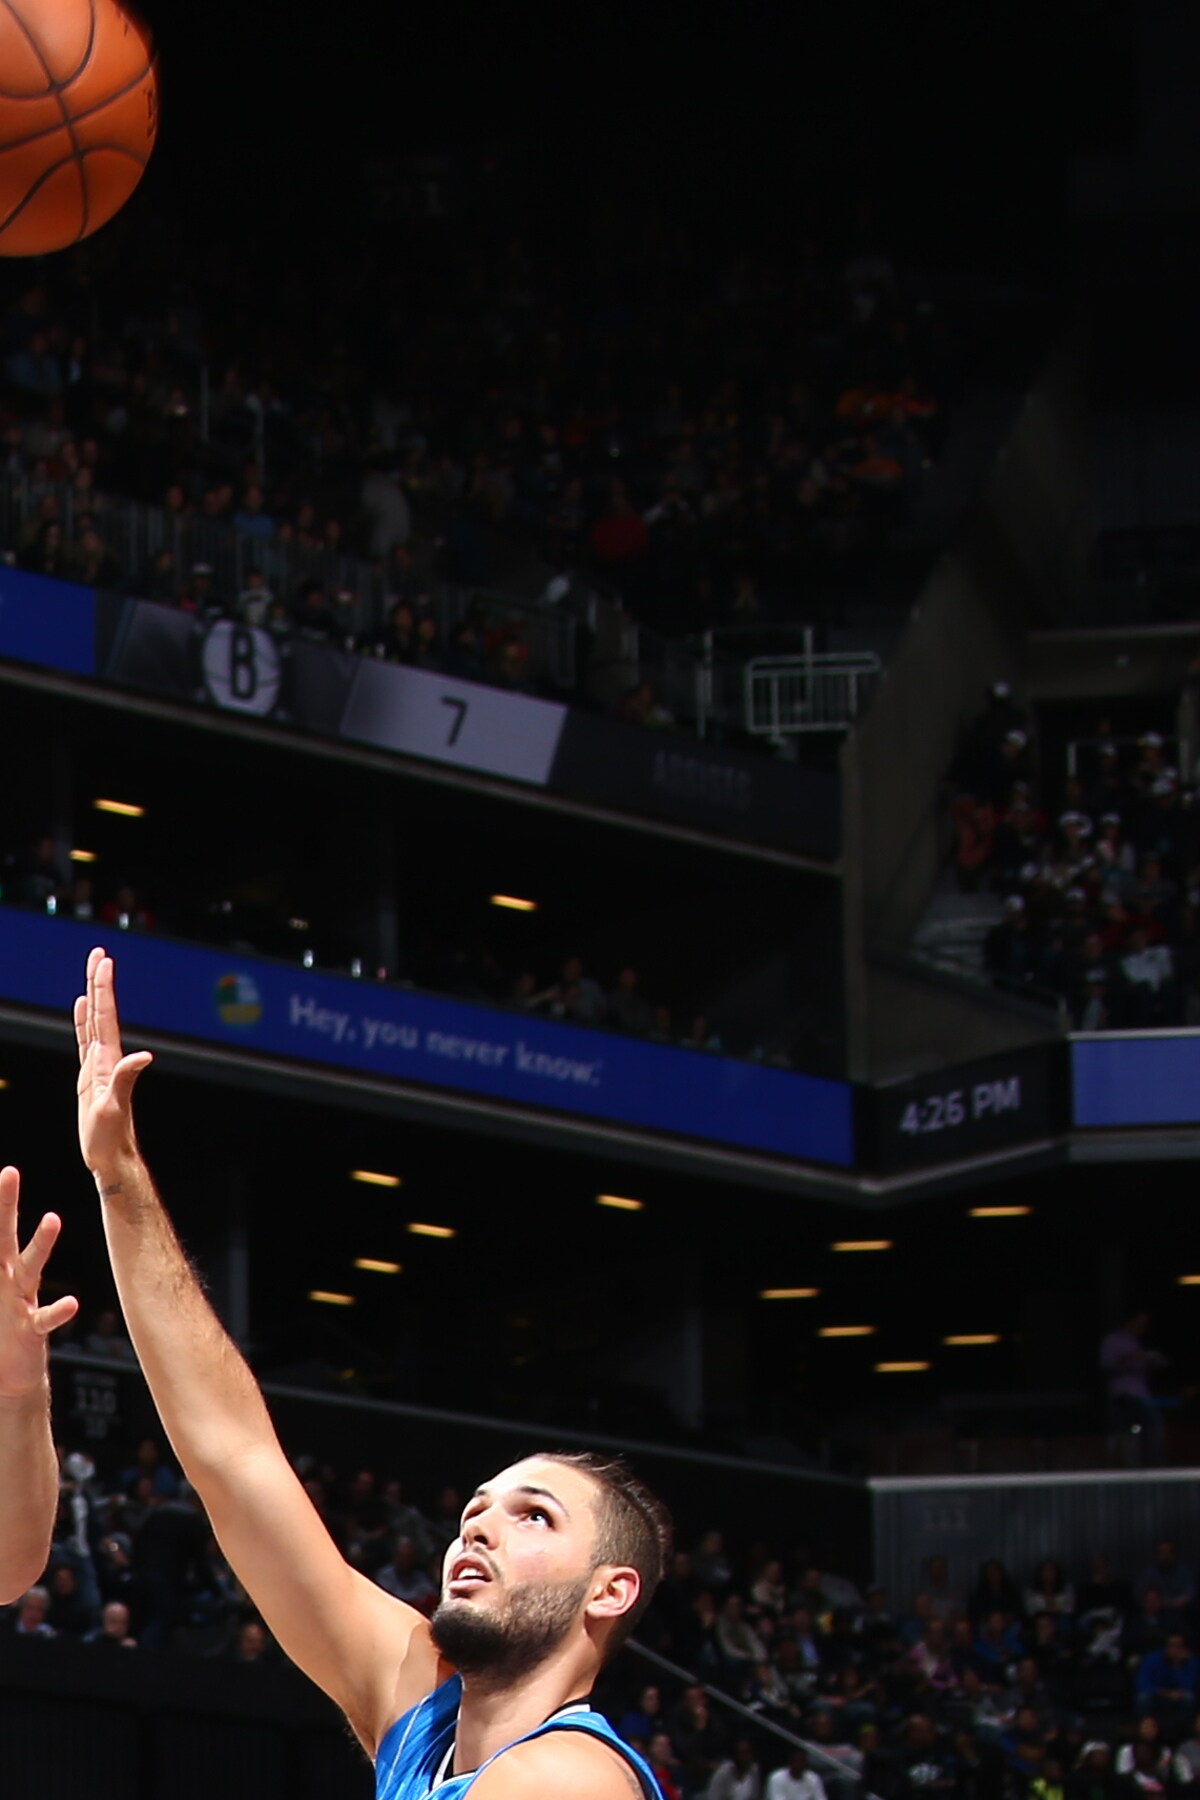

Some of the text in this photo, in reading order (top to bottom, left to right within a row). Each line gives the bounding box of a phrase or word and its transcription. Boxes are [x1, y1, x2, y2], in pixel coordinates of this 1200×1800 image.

[441, 695, 468, 748] 7
[289, 993, 357, 1044] Hey,
[362, 1015, 419, 1050] you
[426, 1028, 509, 1067] never
[898, 1074, 1021, 1137] 4:26 PM
